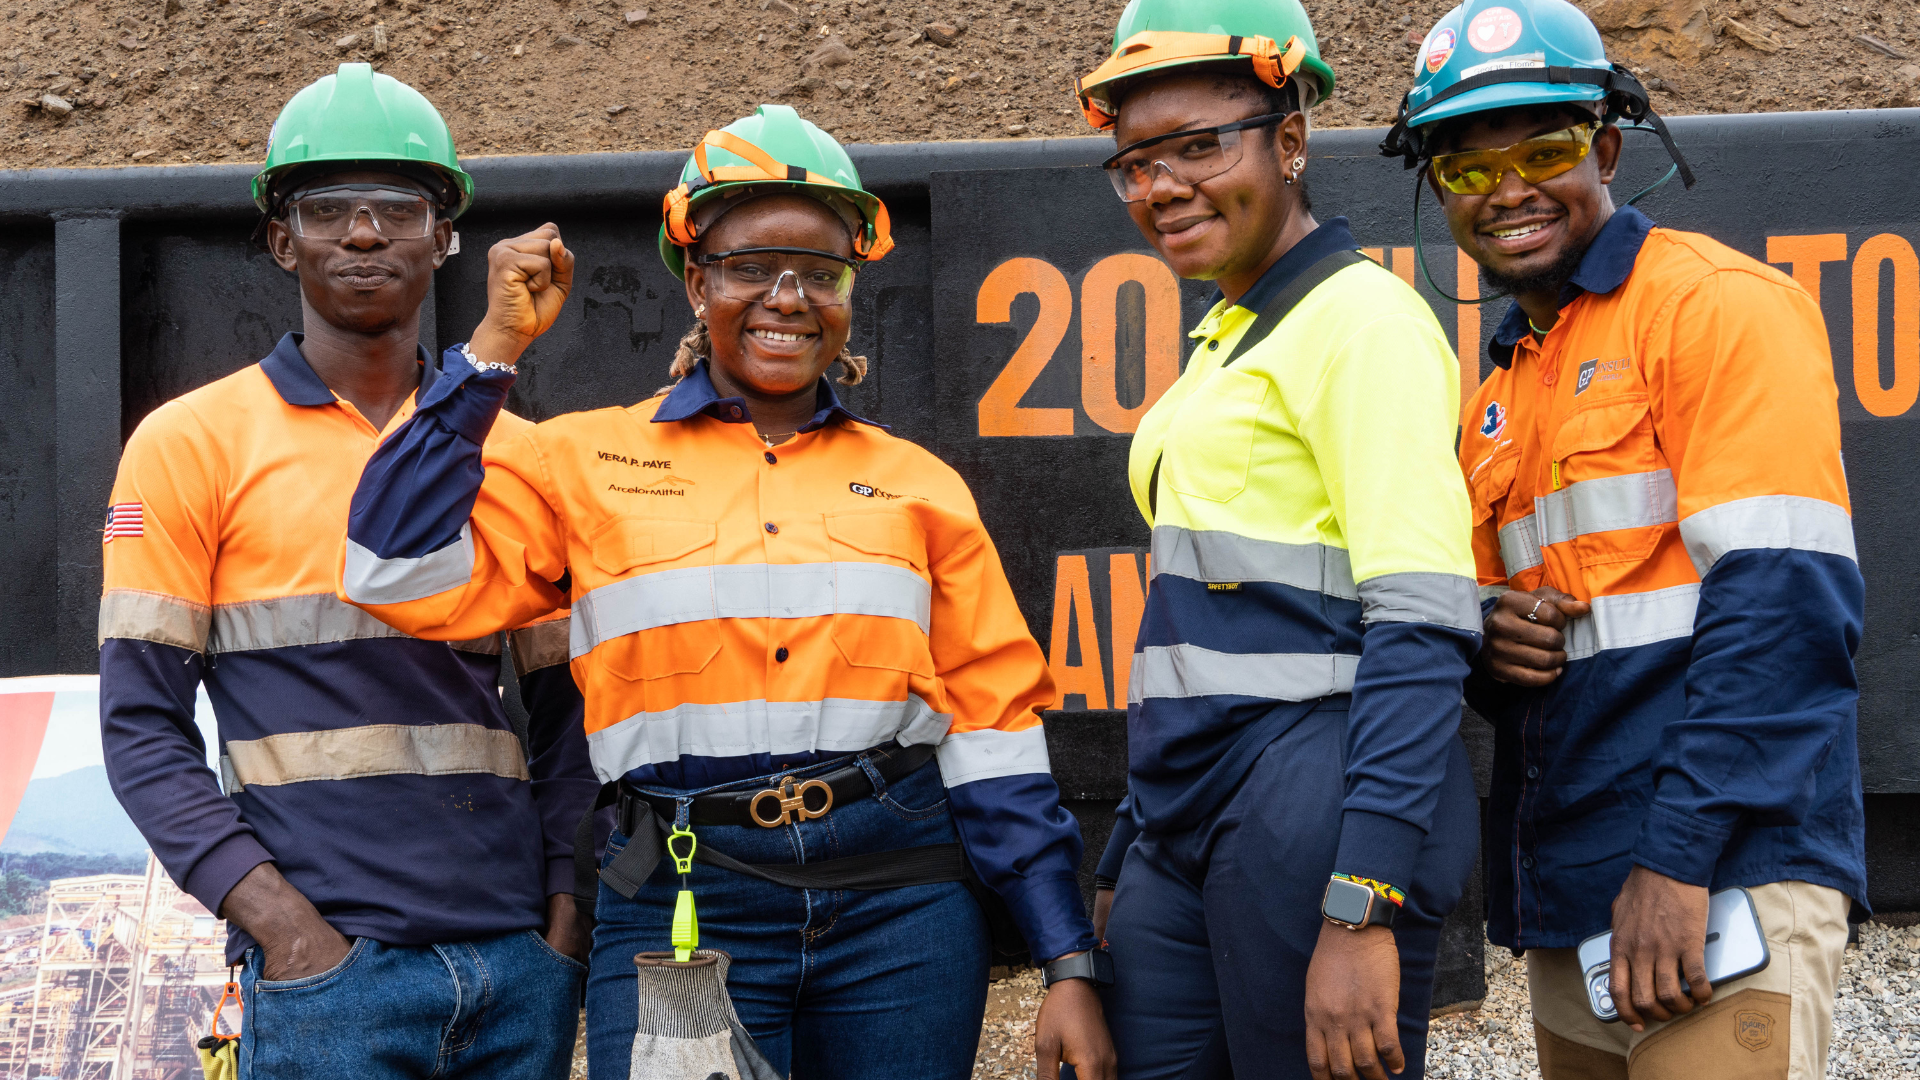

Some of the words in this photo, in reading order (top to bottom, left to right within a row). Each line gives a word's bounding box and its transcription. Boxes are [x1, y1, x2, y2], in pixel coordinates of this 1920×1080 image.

[1486, 8, 1502, 16] CPR
[1478, 16, 1497, 24] FIRST
[976, 253, 1181, 437] 20
[598, 450, 628, 464] VERA
[630, 458, 640, 467] P.
[642, 460, 671, 469] PAYE
[608, 483, 685, 497] ArcelorMittal
